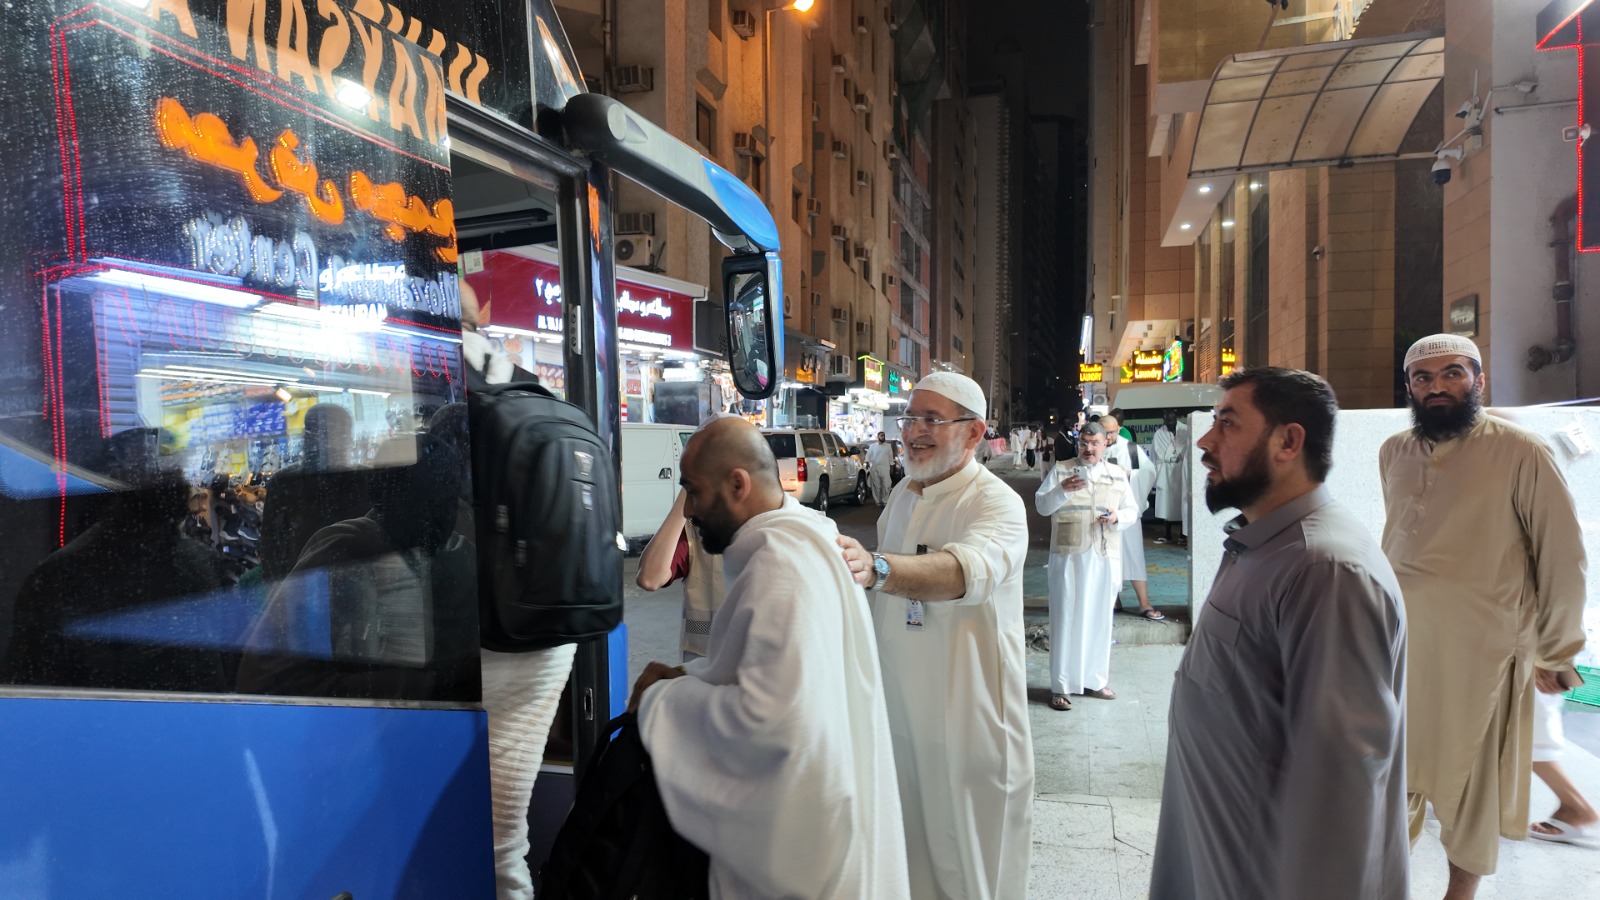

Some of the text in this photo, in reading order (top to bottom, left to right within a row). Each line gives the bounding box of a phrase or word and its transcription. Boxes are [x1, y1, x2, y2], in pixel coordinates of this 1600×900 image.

[1133, 350, 1162, 365] مغسلة
[1079, 372, 1102, 382] LAUNDRY
[1134, 367, 1162, 381] Laundry
